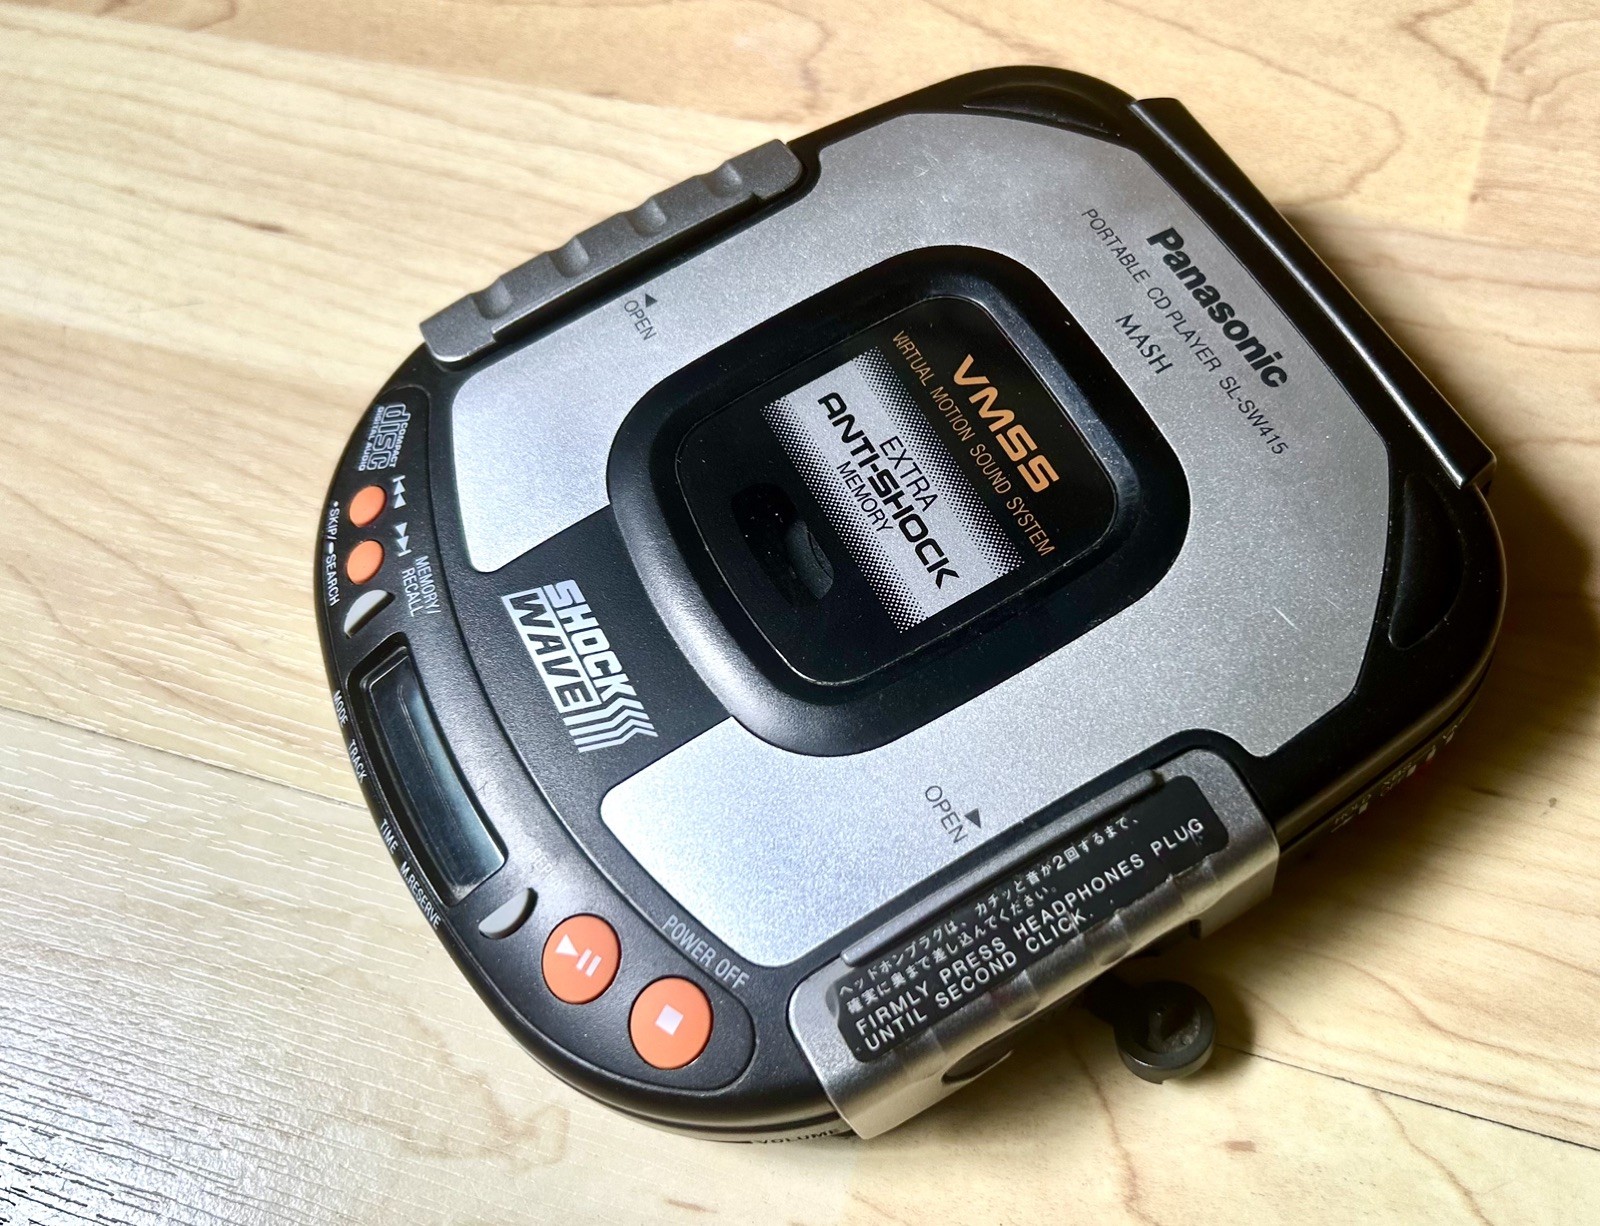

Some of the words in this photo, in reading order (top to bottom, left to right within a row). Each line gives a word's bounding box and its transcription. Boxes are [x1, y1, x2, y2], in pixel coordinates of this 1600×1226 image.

[624, 300, 657, 340] OPEN
[1081, 208, 1151, 284] PORTABLE
[1146, 286, 1172, 311] CD
[1165, 311, 1222, 373] PLAYER
[1218, 376, 1289, 455] SL-SW415
[1146, 227, 1288, 388] Panasonic
[1115, 314, 1173, 375] MASH
[358, 442, 373, 471] AUDIO
[366, 404, 411, 470] disc
[389, 422, 409, 467] COMPACT
[892, 330, 934, 387] VIRTUAL
[930, 386, 976, 442] MOTION
[970, 443, 1012, 495] SOUND
[1006, 496, 1055, 557] SYSTEM
[952, 353, 1060, 493] VMSS
[817, 392, 960, 590] ANTI-SHOCK
[836, 460, 893, 532] MEMORY
[879, 435, 939, 512] EXTRA
[326, 554, 341, 606] SEARCH
[401, 567, 424, 617] RECALL
[415, 555, 441, 614] MEMORY/
[506, 591, 597, 710] WAVE
[543, 579, 637, 702] SHOCK
[333, 690, 349, 728] MODE
[348, 739, 367, 784] TRACK
[380, 819, 399, 854] TIME
[925, 785, 968, 843] OPEN
[400, 861, 442, 930] M.RESERVE
[855, 980, 930, 1036] FIRMLY
[939, 937, 1006, 985] PRESS
[1013, 853, 1145, 940] HEADPHONES
[1150, 818, 1204, 857] PLUG
[662, 914, 716, 967] POWER
[715, 958, 750, 989] OFF
[864, 1008, 927, 1051] UNTIL
[935, 951, 1017, 1009] SECOND
[1025, 908, 1094, 953] CLICK.
